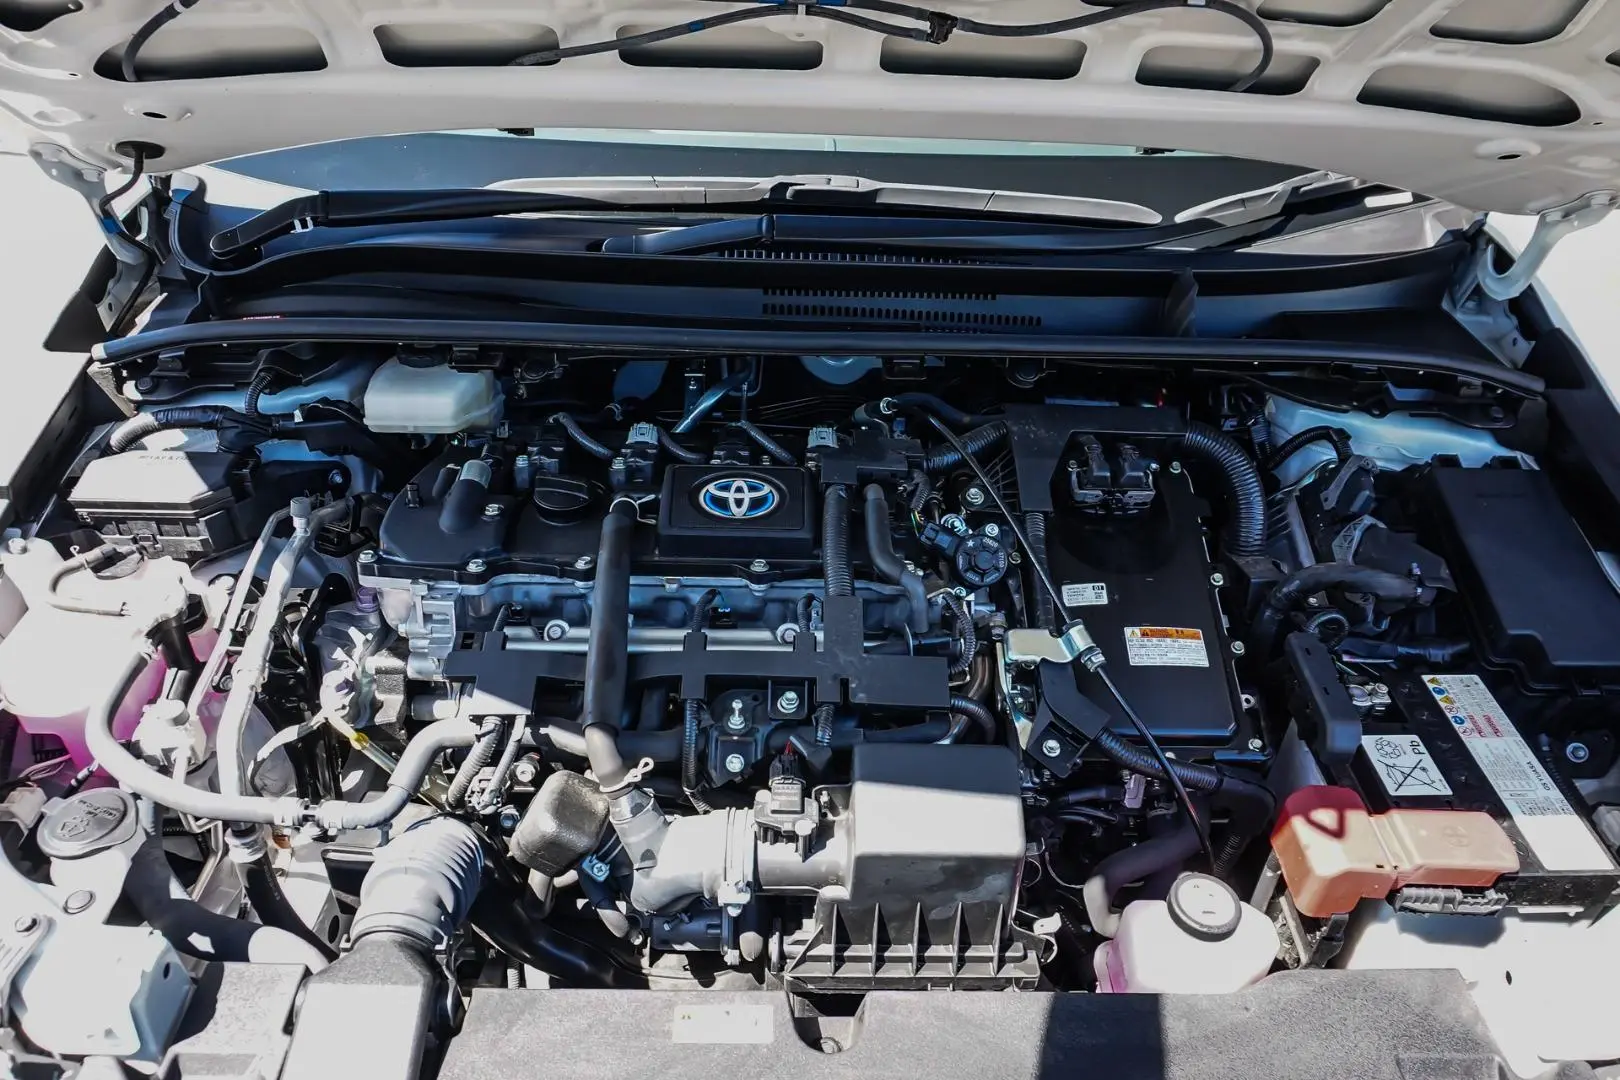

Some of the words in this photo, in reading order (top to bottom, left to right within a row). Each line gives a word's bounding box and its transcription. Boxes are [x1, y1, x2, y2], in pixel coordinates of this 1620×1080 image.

[1409, 740, 1426, 755] Pb
[1526, 761, 1544, 781] YUASA
[1541, 782, 1550, 791] GS
